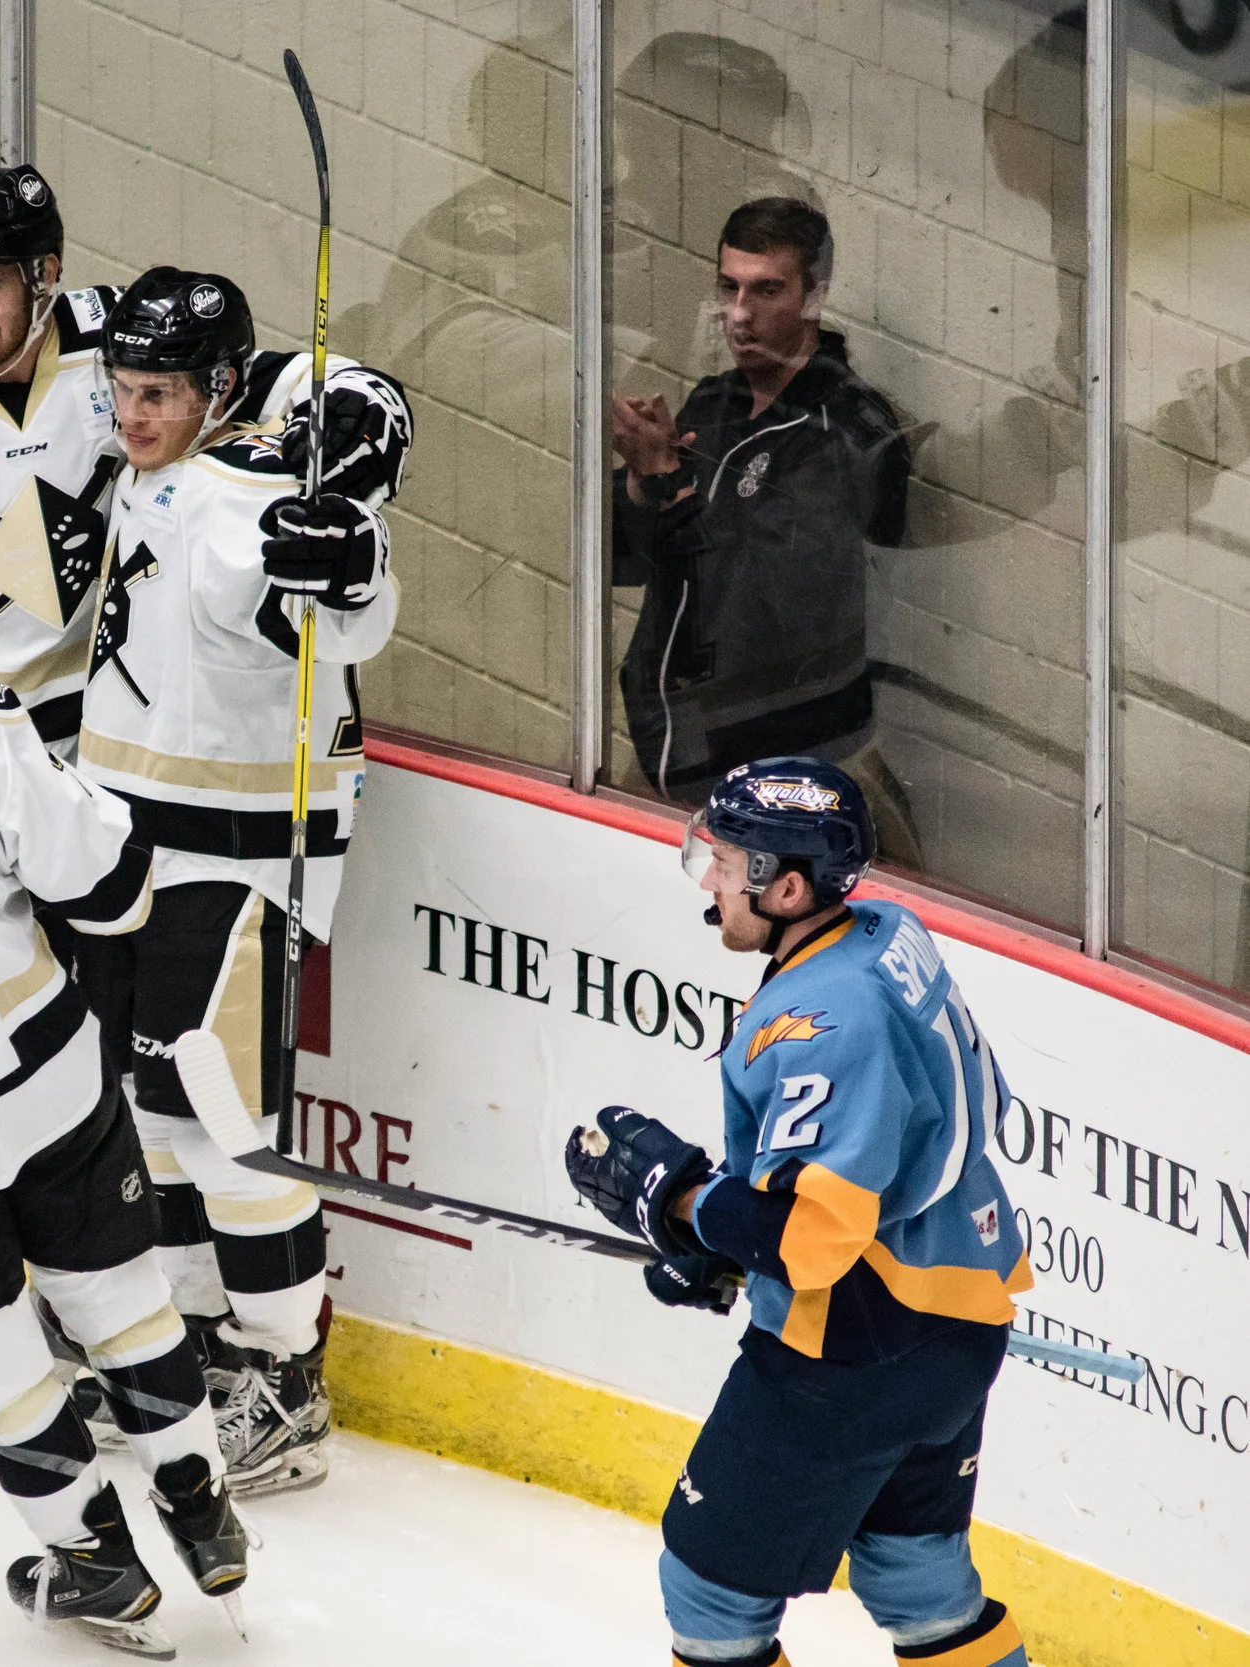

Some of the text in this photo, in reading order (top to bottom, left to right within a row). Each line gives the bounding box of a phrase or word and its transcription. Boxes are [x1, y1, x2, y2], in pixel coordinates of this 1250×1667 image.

[317, 297, 328, 347] CCM
[113, 331, 153, 347] CCM
[5, 442, 49, 459] CCM
[288, 898, 302, 962] CCM
[863, 913, 884, 937] CCM
[413, 903, 552, 1006] THE
[995, 1094, 1071, 1180] OF
[1083, 1124, 1200, 1237] THE
[1215, 1179, 1250, 1262] N
[662, 1263, 692, 1289] CCM
